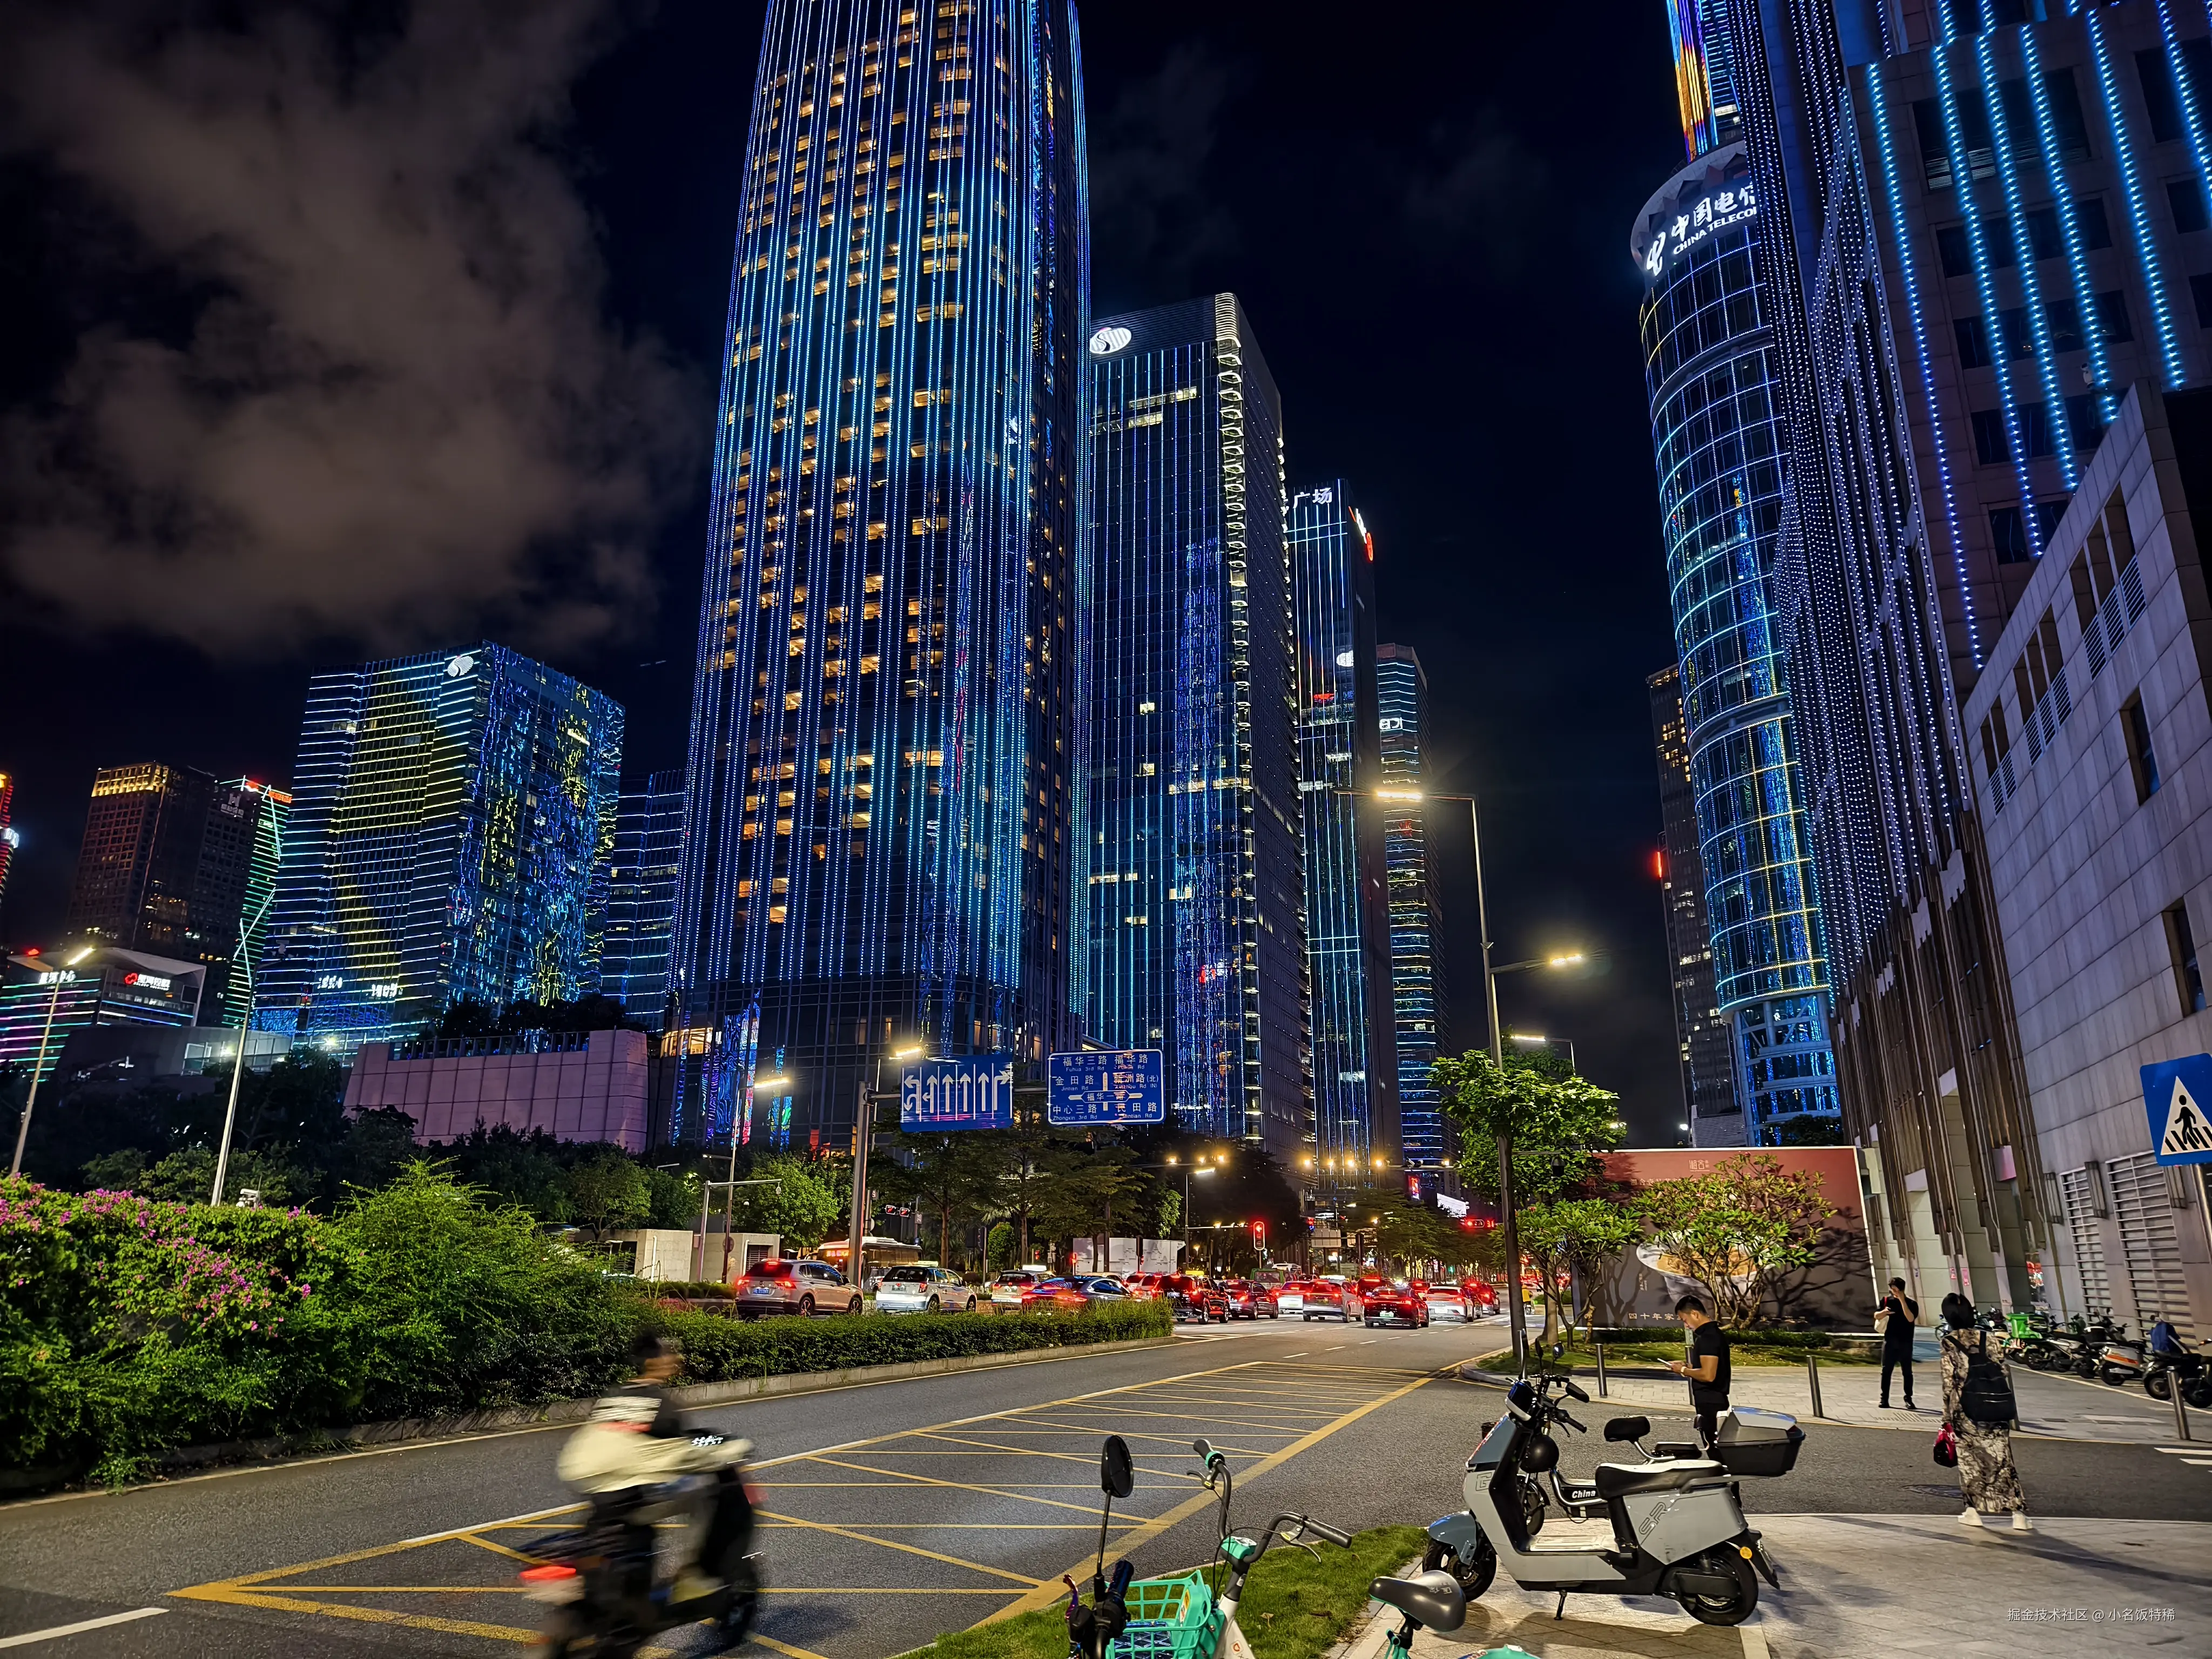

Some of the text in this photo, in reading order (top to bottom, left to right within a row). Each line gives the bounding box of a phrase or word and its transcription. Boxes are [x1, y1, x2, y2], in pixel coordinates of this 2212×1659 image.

[1673, 230, 1707, 255] CHINA
[1293, 487, 1332, 509] 广场
[1063, 1055, 1107, 1067] 福华三路
[1115, 1054, 1148, 1065] 福华路
[1055, 1075, 1094, 1086] 金田路
[1053, 1104, 1097, 1115] 中心三路
[1572, 1490, 1596, 1499] China
